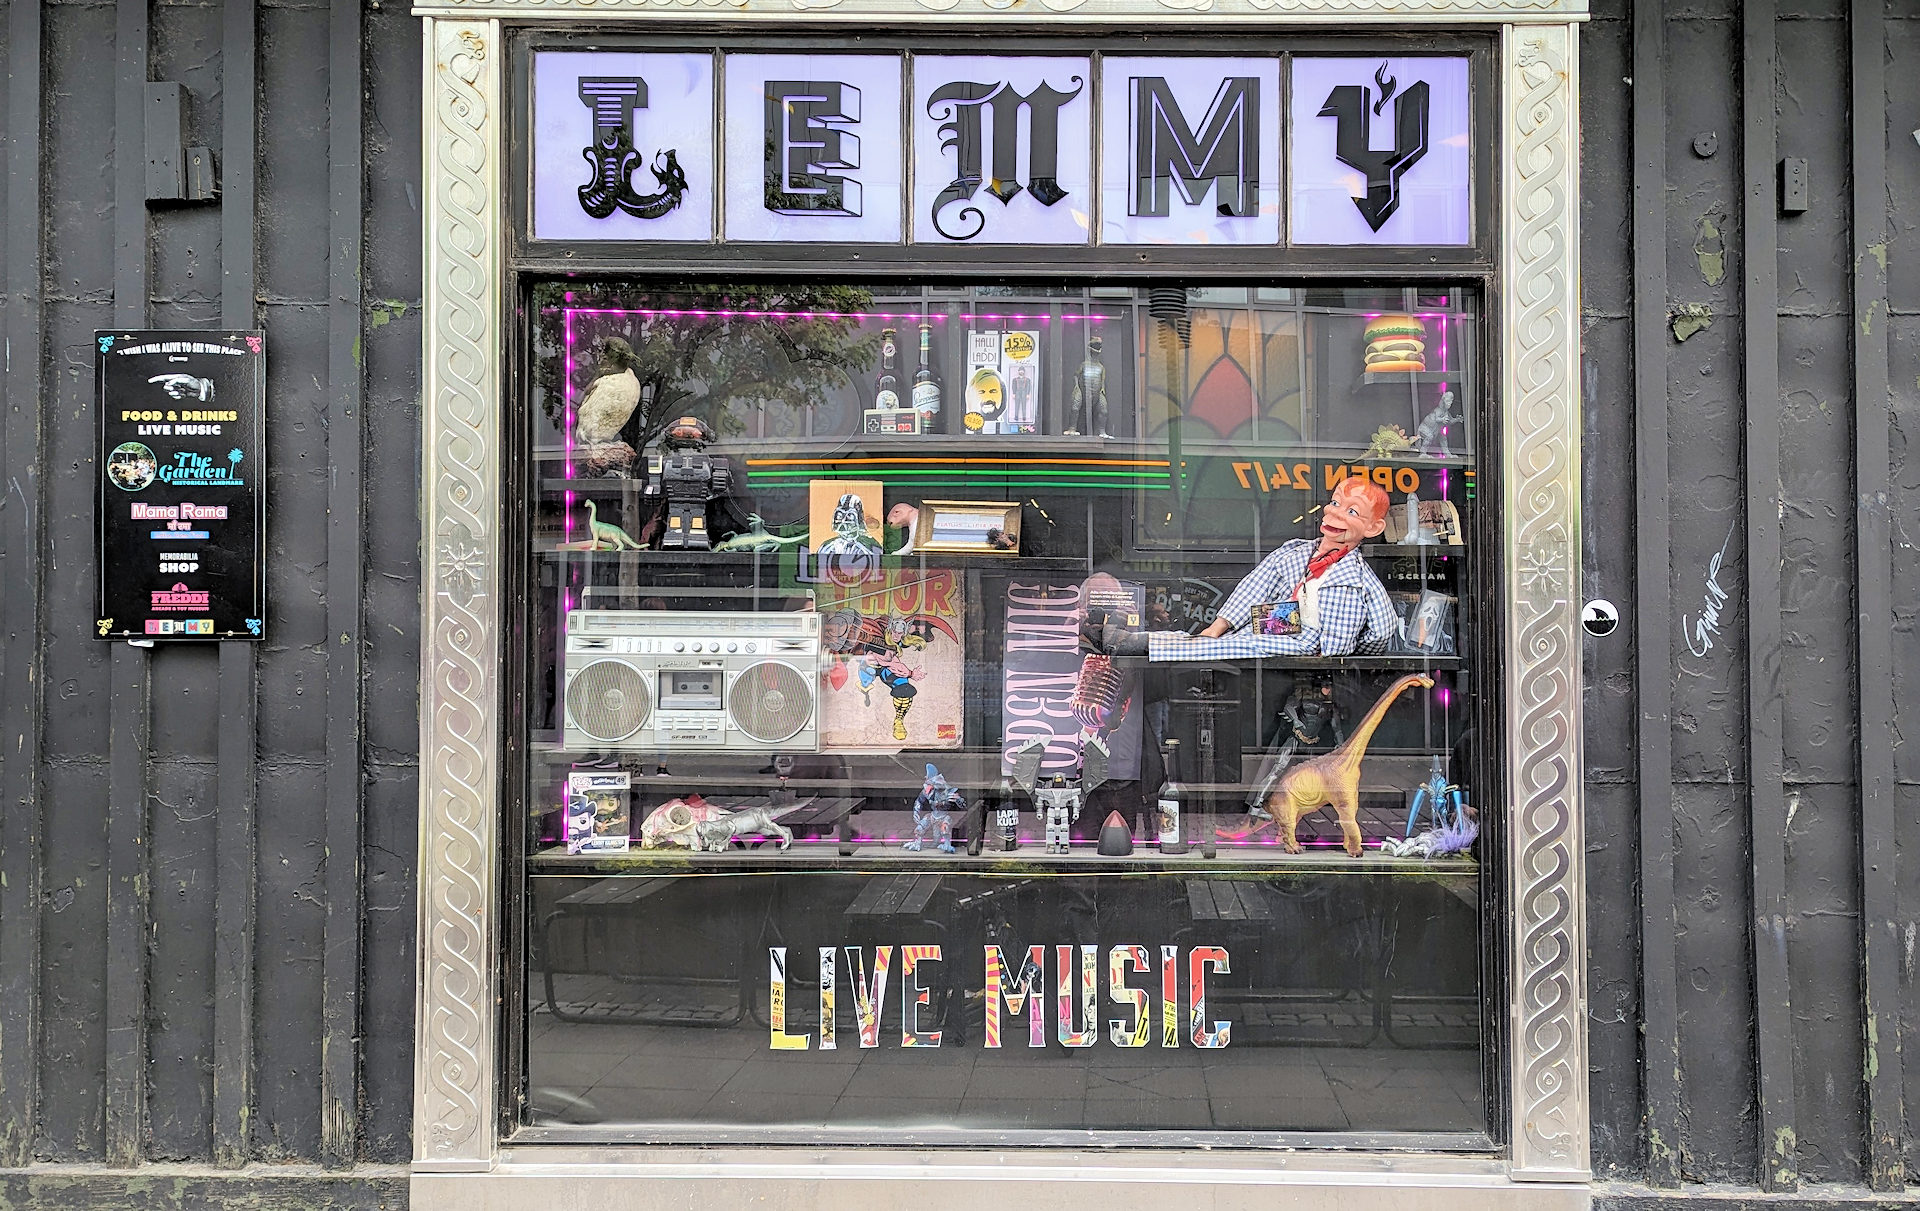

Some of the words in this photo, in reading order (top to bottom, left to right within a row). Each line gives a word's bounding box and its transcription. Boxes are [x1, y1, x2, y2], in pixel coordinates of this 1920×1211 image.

[578, 60, 1430, 240] LEMMY
[145, 342, 161, 354] WAS
[161, 341, 181, 353] ALIVE
[181, 341, 192, 353] TO
[192, 342, 204, 354] SEE
[205, 343, 221, 355] THIS
[1006, 336, 1031, 349] 15%
[972, 352, 997, 362] LADDI
[121, 410, 163, 422] FOOD
[166, 410, 177, 422] &
[181, 410, 238, 422] DRINKS
[137, 424, 172, 436] LIVE
[174, 424, 222, 436] MUSIC
[173, 451, 213, 468] The
[158, 464, 227, 484] Garden
[131, 503, 179, 519] Mama
[180, 503, 228, 519] Rama
[159, 552, 199, 561] MEMORABILIA
[159, 562, 200, 573] SHOP
[1398, 573, 1446, 581] SCREAM
[823, 566, 957, 616] THOR
[151, 593, 209, 604] FREDDI
[1005, 582, 1081, 657] MIC
[1004, 668, 1081, 770] OPEN
[615, 775, 625, 784] 49
[996, 809, 1019, 819] LAPIN
[996, 817, 1019, 827] KULTA
[769, 944, 943, 1051] LIVE
[983, 944, 1232, 1049] MUSIC
